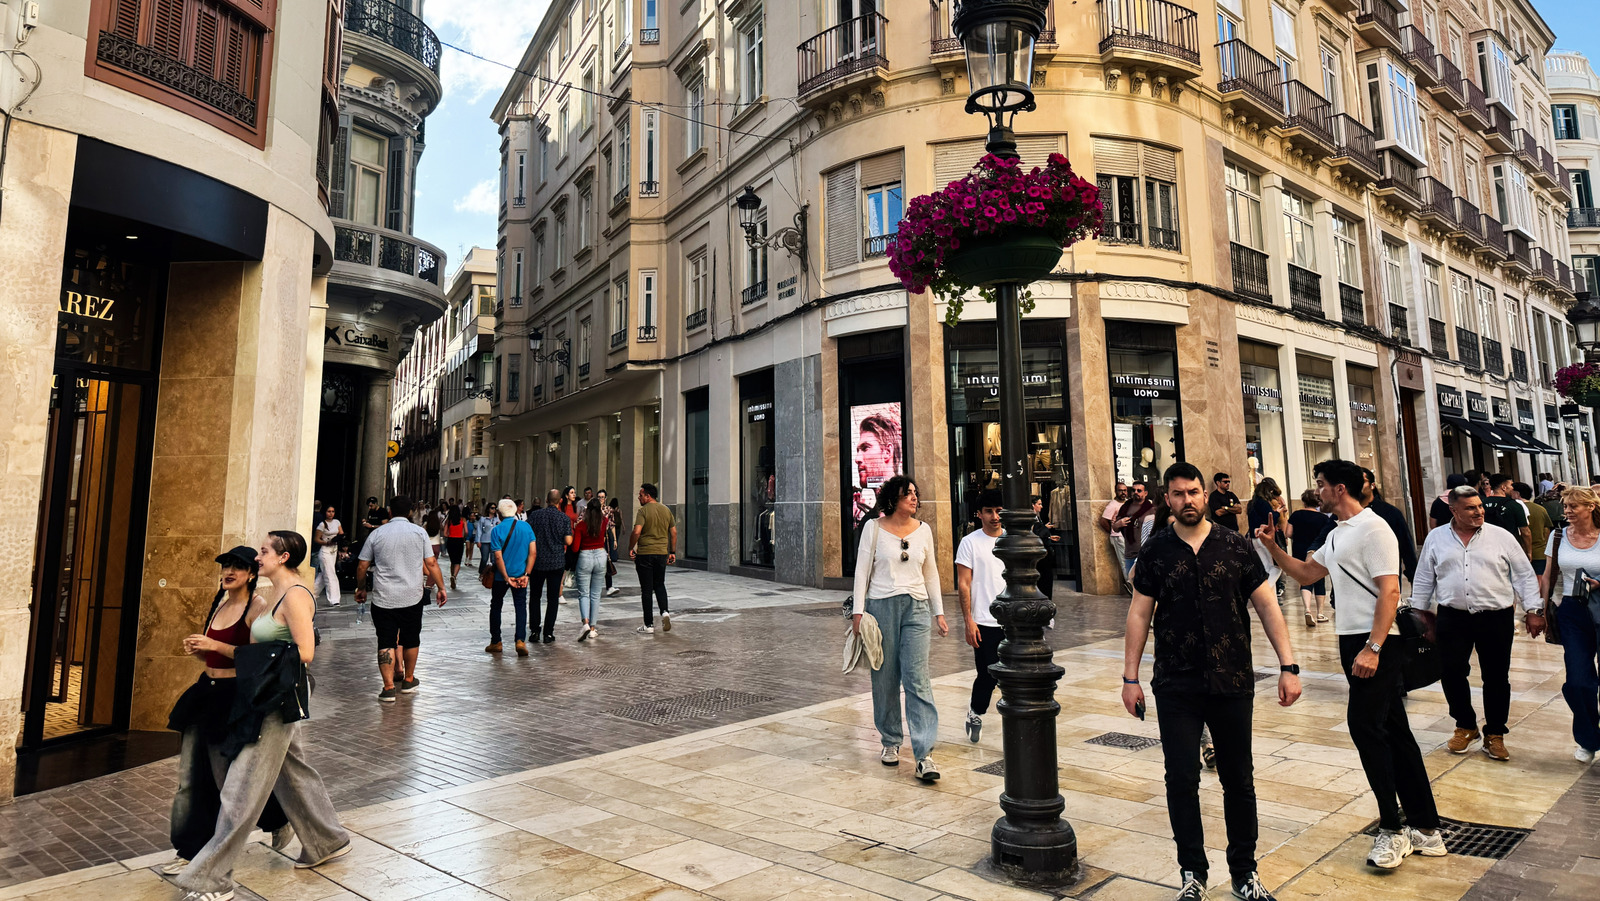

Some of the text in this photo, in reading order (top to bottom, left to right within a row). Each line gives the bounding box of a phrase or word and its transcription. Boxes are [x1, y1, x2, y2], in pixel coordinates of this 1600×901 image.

[1102, 203, 1112, 211] SV
[344, 329, 389, 349] CaixaBank
[967, 375, 1047, 384] intimimi
[1115, 375, 1175, 387] intimissimi
[1133, 389, 1159, 397] UOMO
